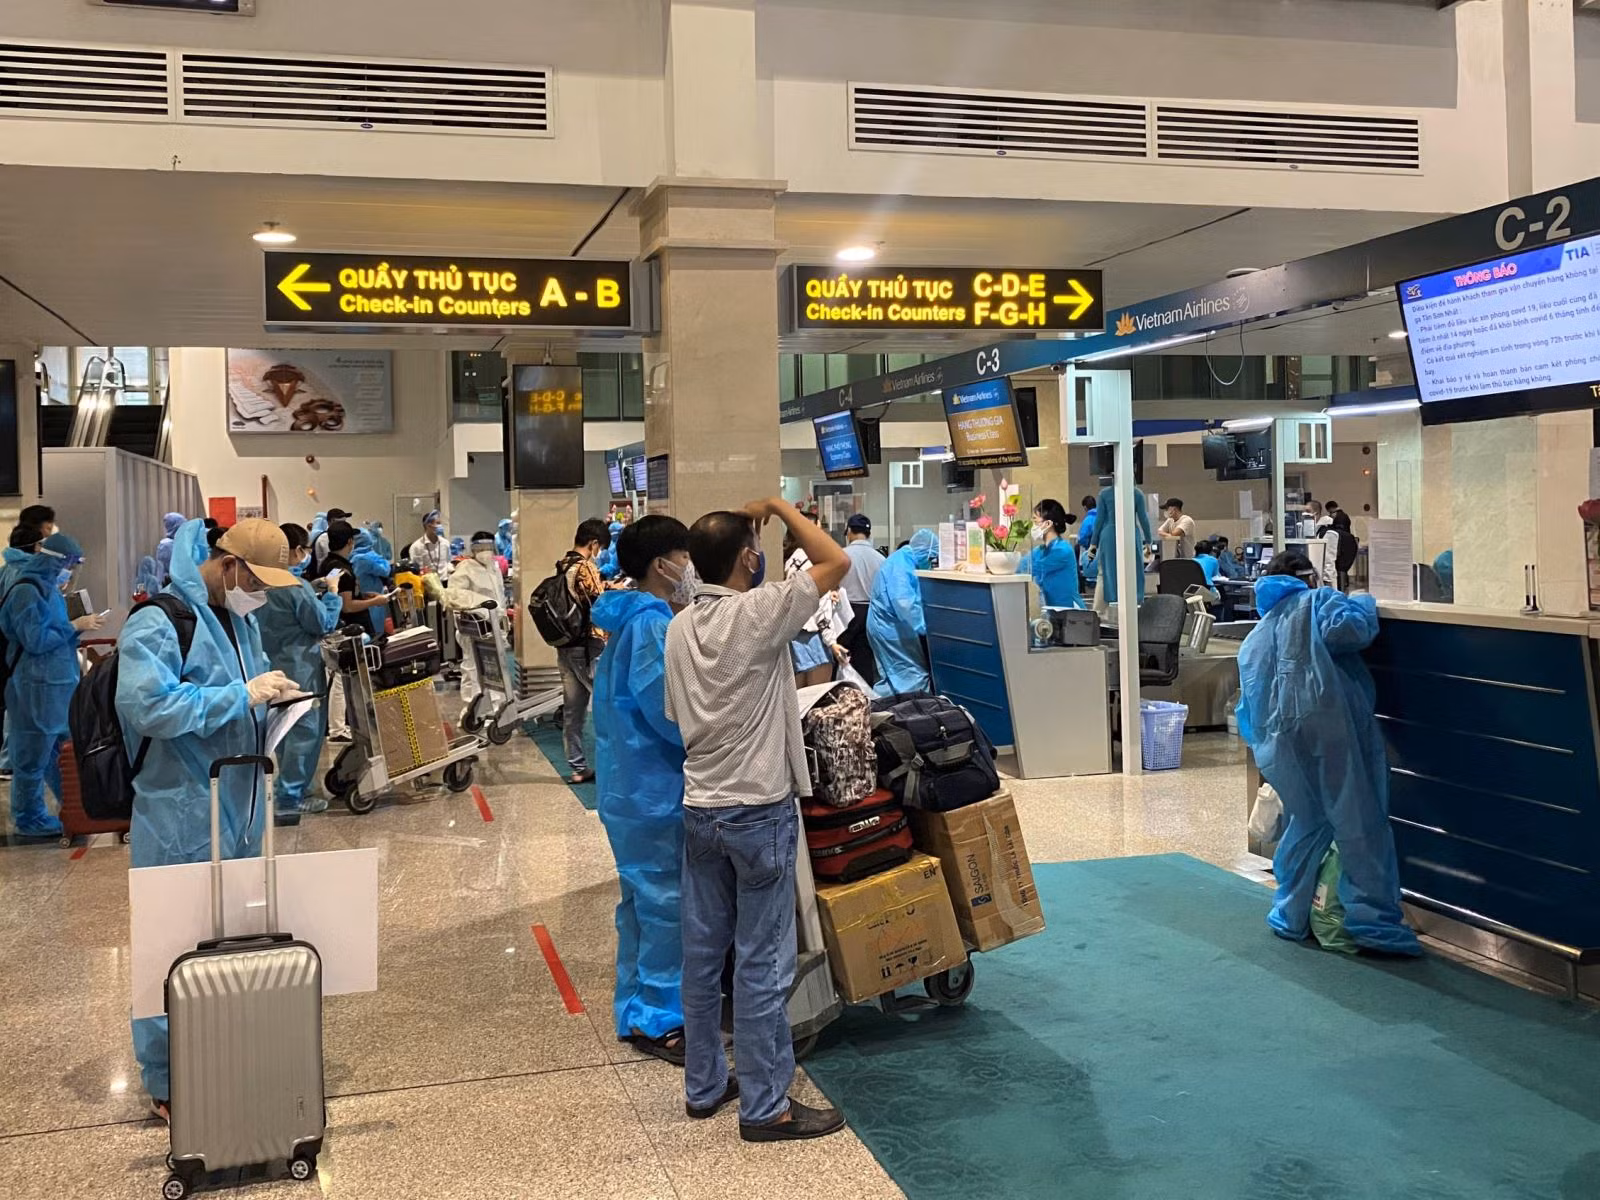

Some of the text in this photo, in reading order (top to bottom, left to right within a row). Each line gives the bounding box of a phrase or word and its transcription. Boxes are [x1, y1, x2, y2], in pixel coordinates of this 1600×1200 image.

[1495, 196, 1571, 250] C-2
[1565, 246, 1590, 261] TIA
[414, 264, 463, 290] THỦ
[468, 272, 517, 295] TỤC
[973, 273, 1046, 298] C-D-E
[1454, 262, 1518, 288] THÔNG BÁO
[540, 278, 567, 307] A
[597, 279, 621, 307] B
[867, 275, 908, 299] THỦ
[912, 280, 953, 302] TỤC
[339, 294, 531, 316] Check-in Counters
[806, 303, 966, 321] Check-in Counters
[974, 302, 1046, 325] F-G-H
[1136, 296, 1230, 331] Vietnam Airlines
[976, 348, 1000, 375] C-3
[923, 868, 936, 880] EN
[968, 854, 984, 894] SAIGON
